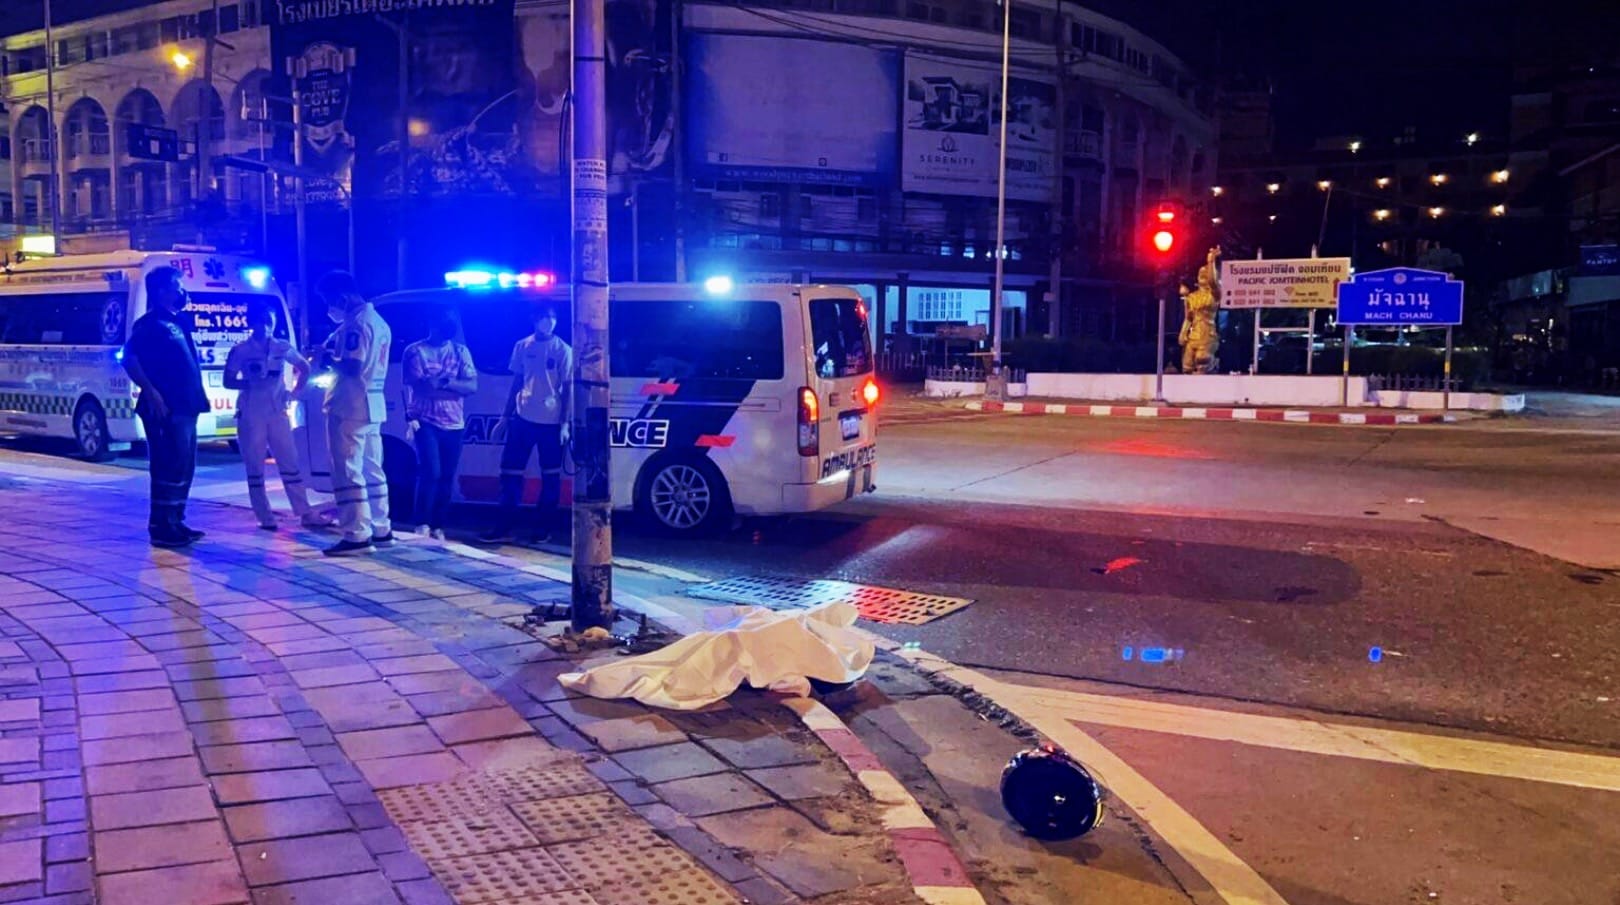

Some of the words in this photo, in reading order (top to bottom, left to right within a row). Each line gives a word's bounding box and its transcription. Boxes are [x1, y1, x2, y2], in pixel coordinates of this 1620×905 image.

[302, 88, 341, 106] COVE
[920, 154, 975, 166] SERENITY
[1368, 288, 1430, 310] มัจฉานุ
